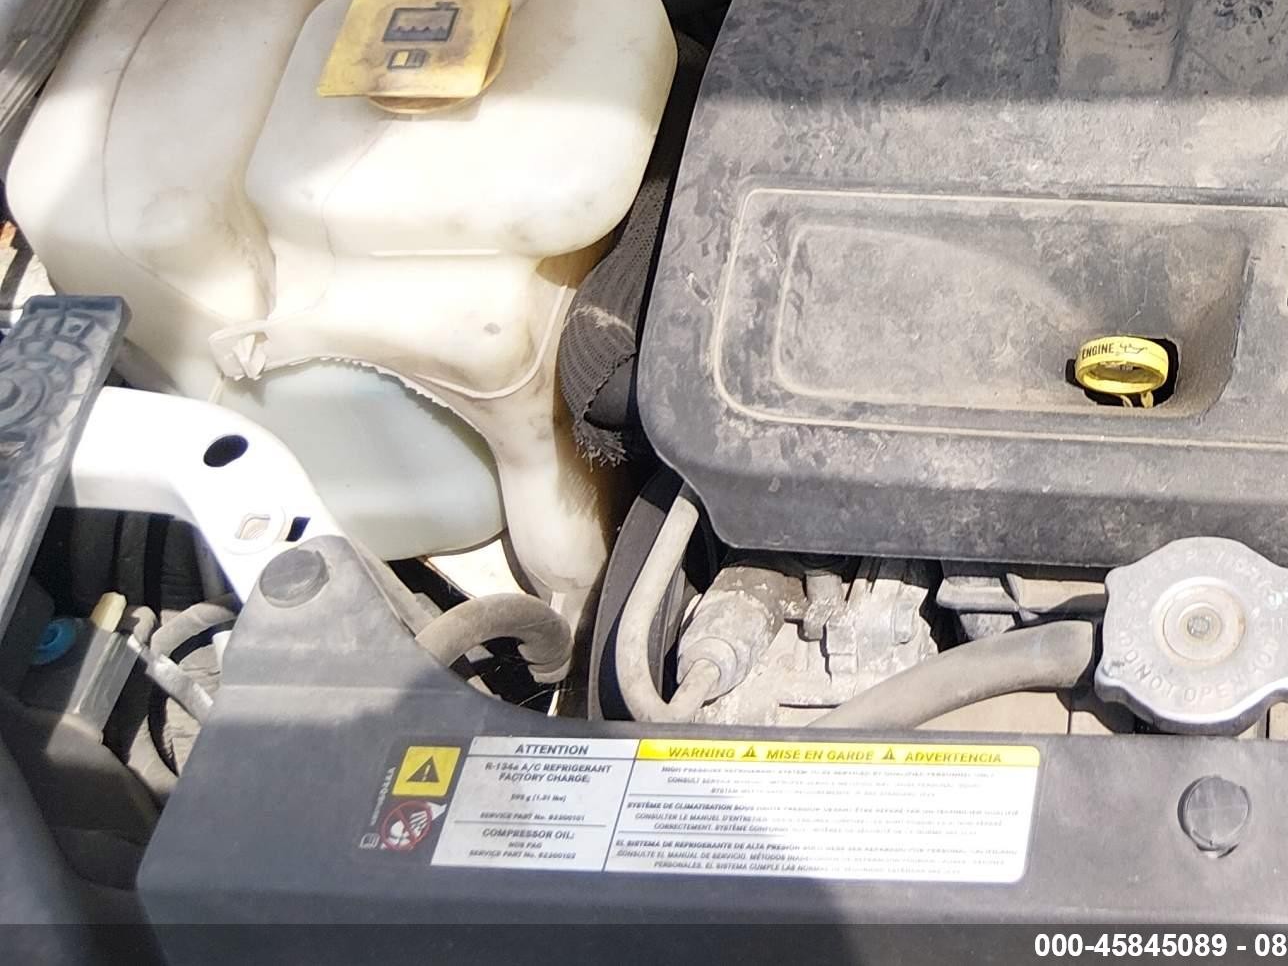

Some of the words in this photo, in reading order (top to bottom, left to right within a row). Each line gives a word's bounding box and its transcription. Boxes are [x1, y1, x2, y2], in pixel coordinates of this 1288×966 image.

[1082, 342, 1115, 359] ENGINE
[1139, 664, 1177, 699] NOT
[1183, 675, 1249, 703] OPEN
[514, 744, 589, 755] ATTENTION
[669, 746, 736, 759] WARNING
[766, 749, 800, 760] MISE
[804, 750, 824, 761] EN
[827, 750, 874, 762] GARDE
[905, 751, 1002, 763] ADVERTENCIA
[485, 762, 519, 772] R-134a
[520, 763, 541, 773] A/C
[543, 764, 611, 774] REFRIGERANT
[498, 772, 547, 783] FACTORY
[482, 829, 554, 840] COMPRESSOR
